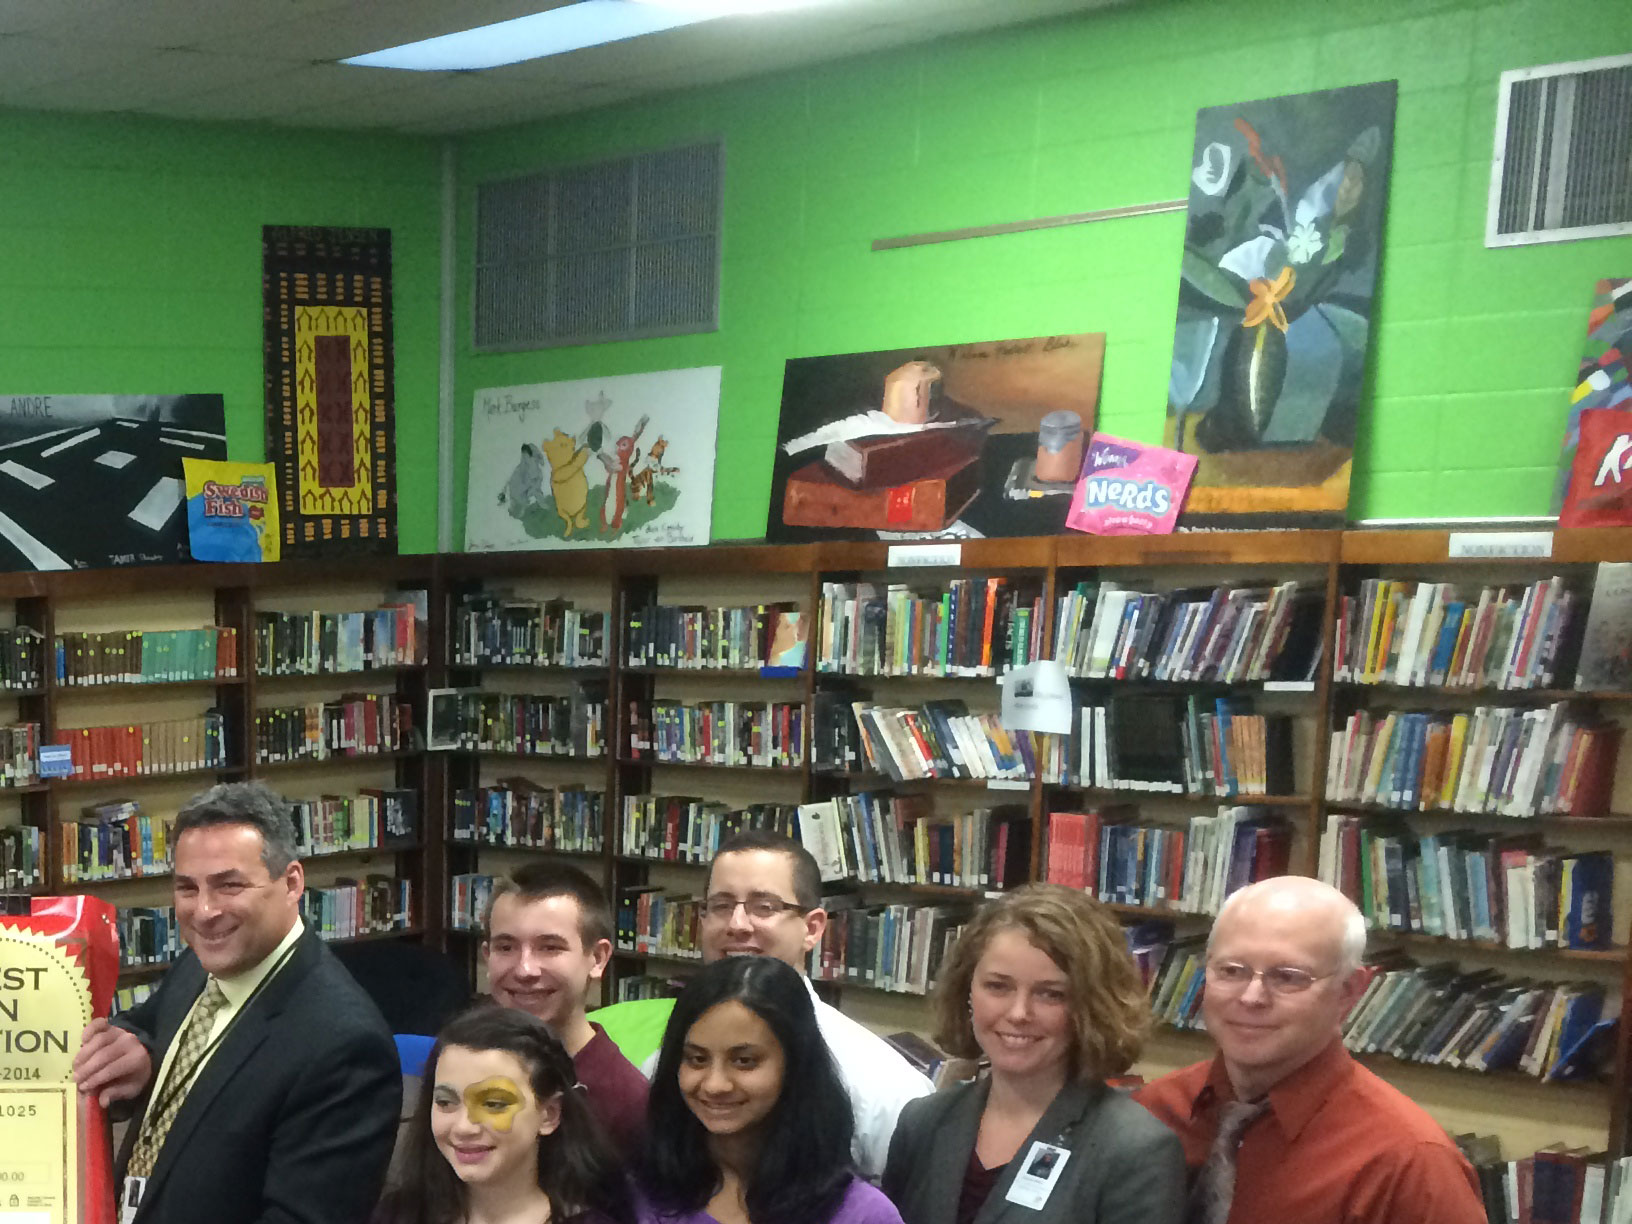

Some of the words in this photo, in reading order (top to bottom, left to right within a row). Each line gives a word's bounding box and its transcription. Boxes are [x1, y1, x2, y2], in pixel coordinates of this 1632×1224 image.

[10, 396, 53, 418] ANDRE
[204, 481, 268, 503] Swedish
[204, 500, 244, 517] Fish
